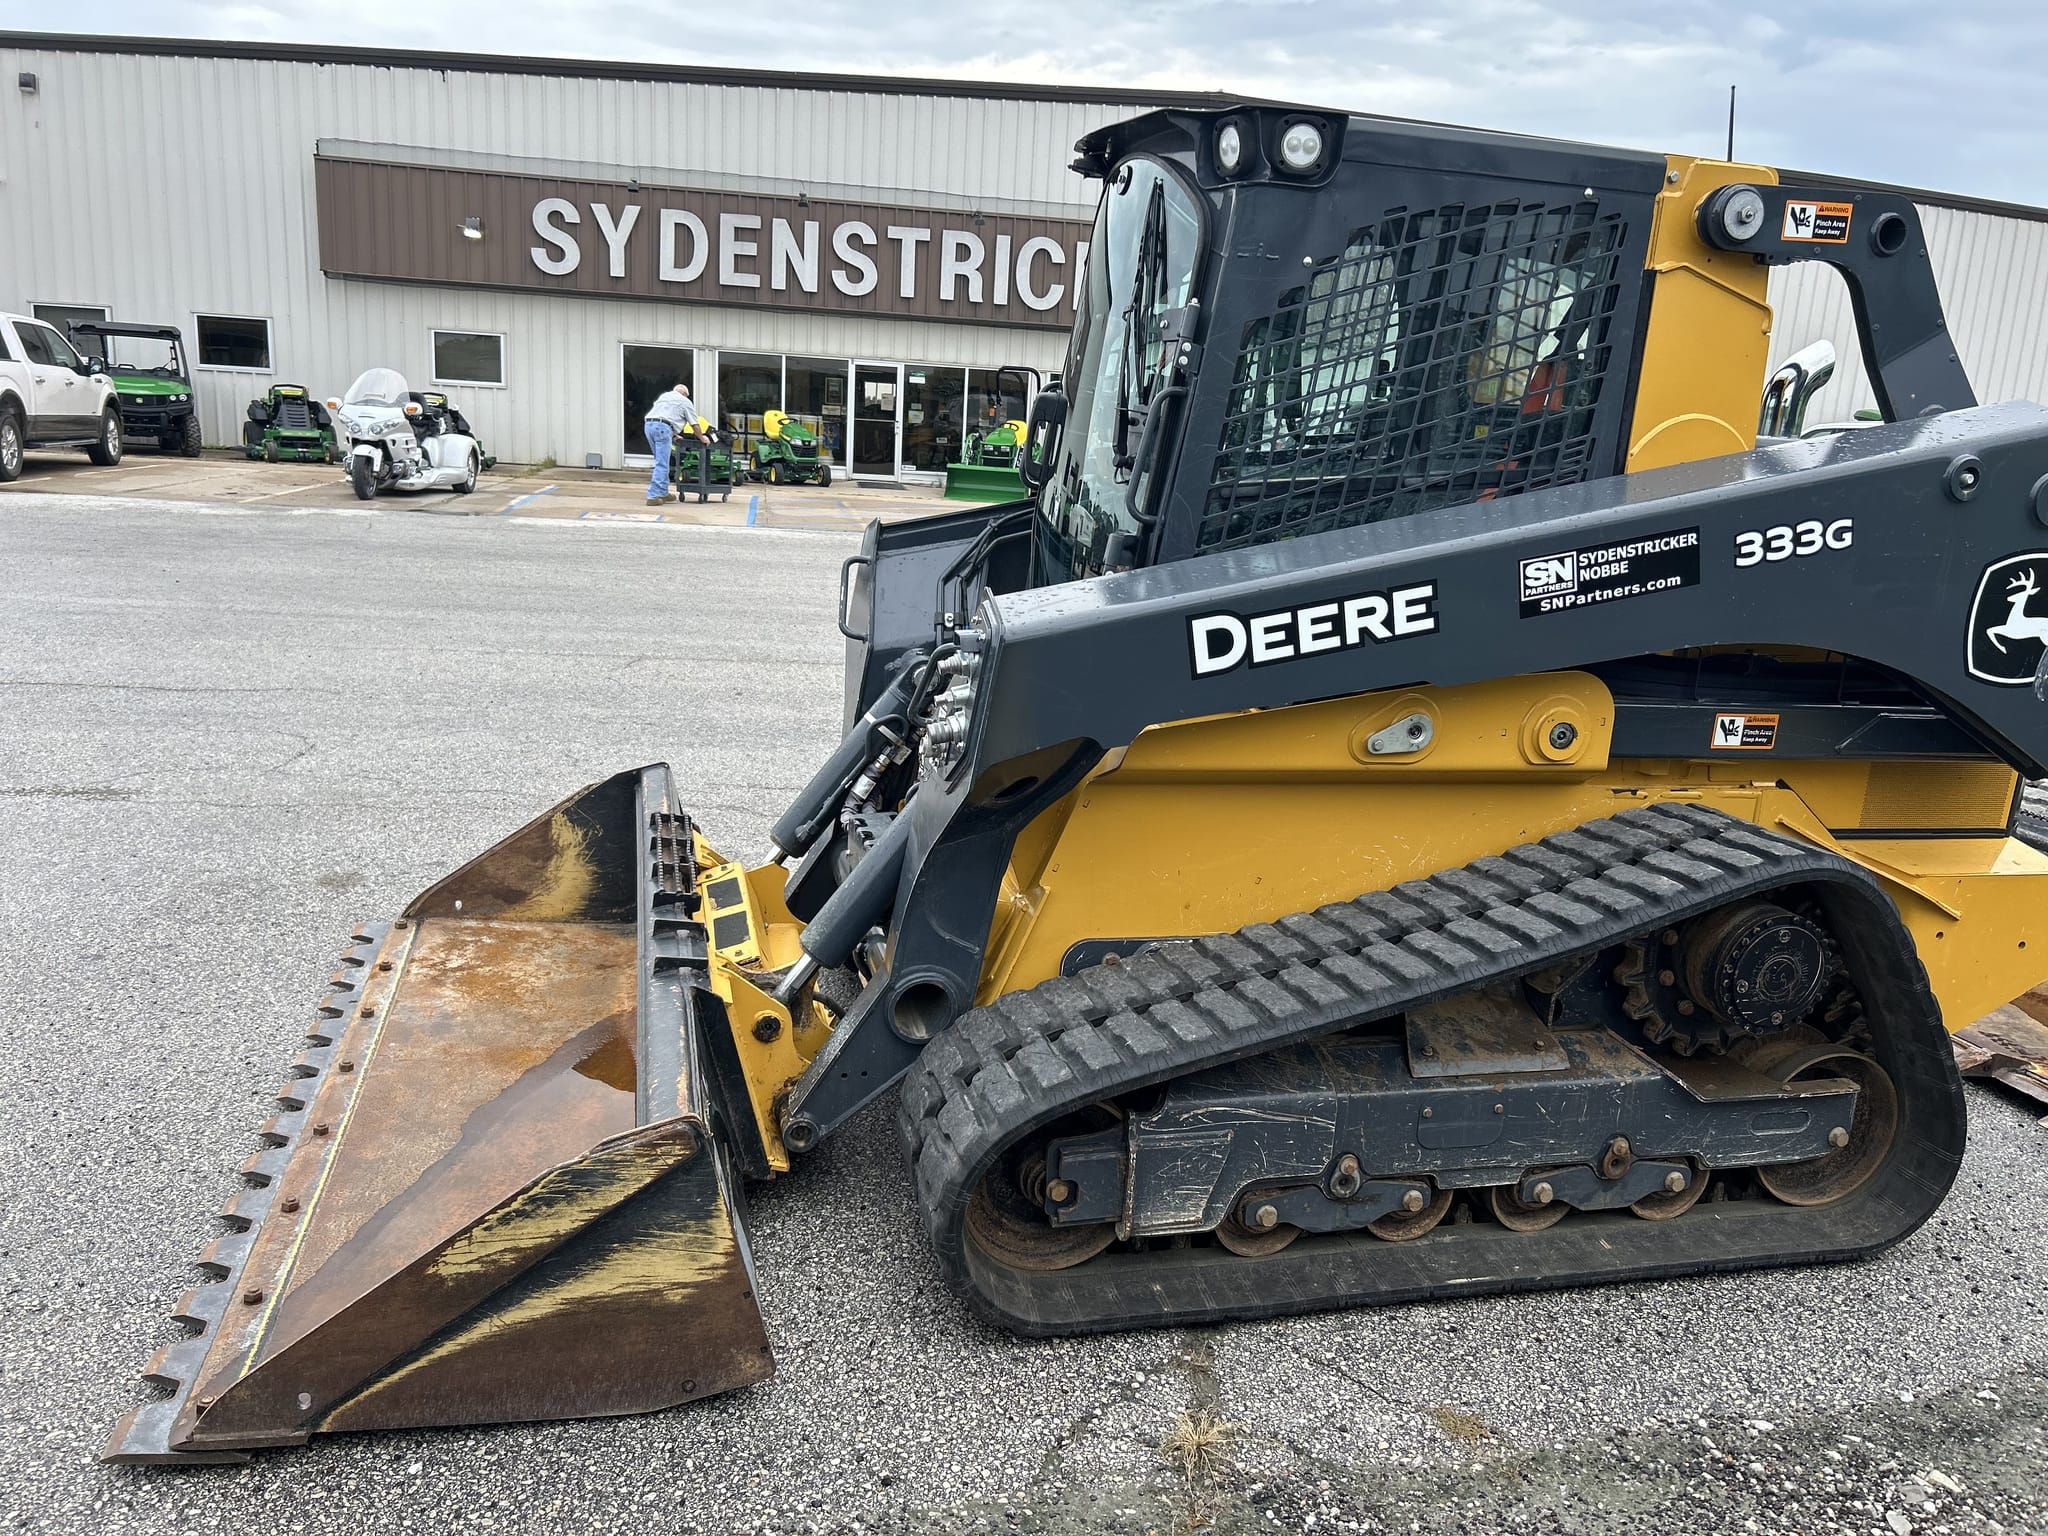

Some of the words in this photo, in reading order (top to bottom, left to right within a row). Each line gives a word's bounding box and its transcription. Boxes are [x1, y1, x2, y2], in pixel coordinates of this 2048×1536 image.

[1825, 206, 1849, 214] WARNING
[1814, 228, 1827, 236] Keep
[1815, 219, 1832, 227] Pinch
[1833, 220, 1846, 228] Area
[1578, 532, 1698, 567] SYDENSTRICKER
[1736, 519, 1853, 566] 333G
[1524, 557, 1574, 588] SN
[1579, 561, 1629, 582] NOBBE
[1525, 581, 1574, 597] PARTNERS
[1540, 575, 1682, 612] SNPartners.com
[1191, 585, 1435, 674] DEERE
